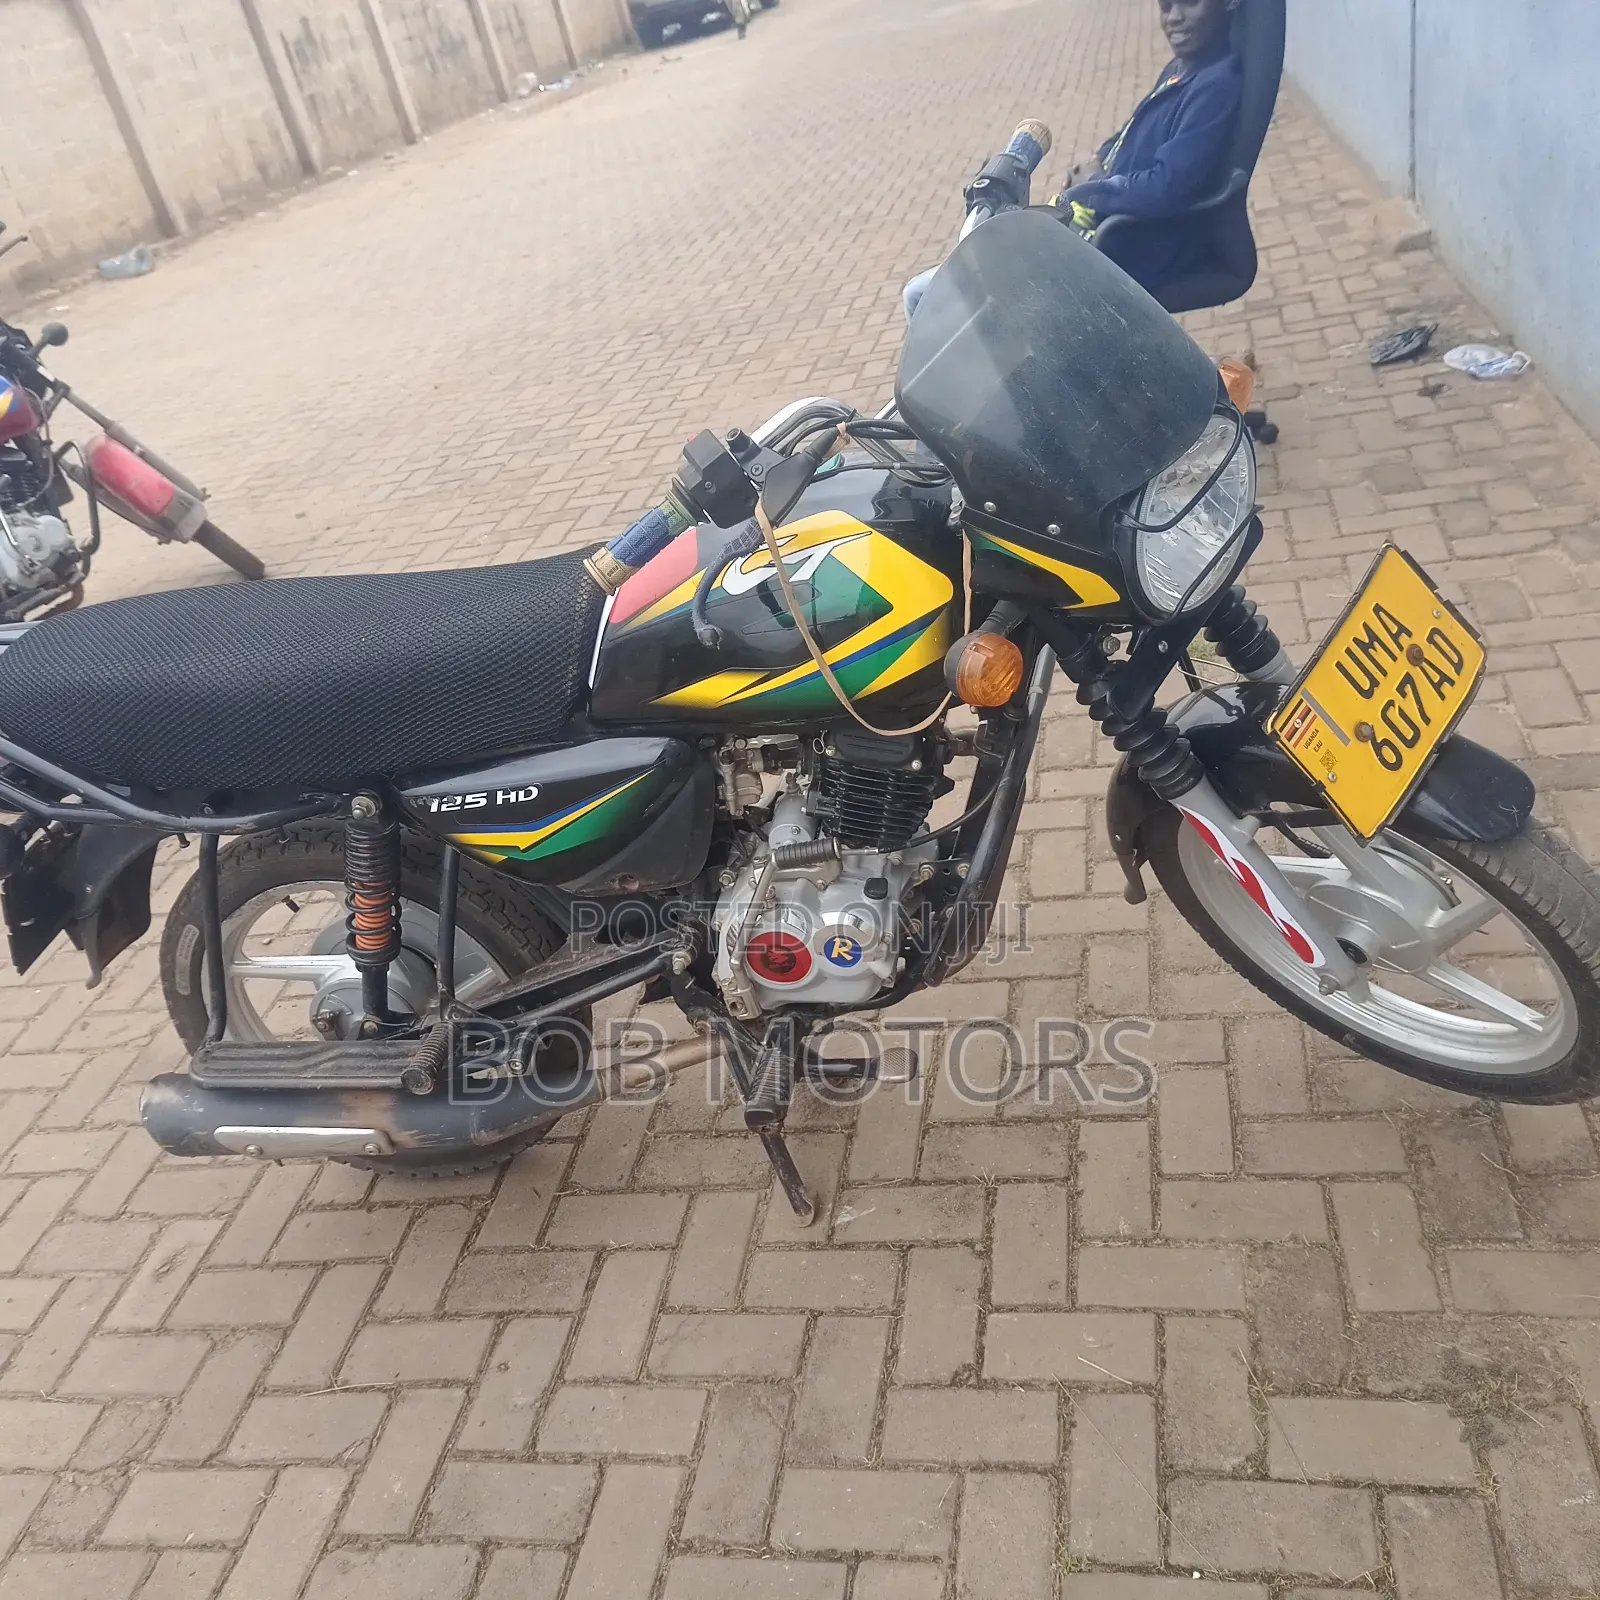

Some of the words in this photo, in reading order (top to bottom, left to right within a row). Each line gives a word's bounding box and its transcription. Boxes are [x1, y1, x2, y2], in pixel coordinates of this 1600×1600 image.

[1335, 602, 1413, 700] UMA
[1369, 627, 1464, 771] 607AD
[1304, 728, 1319, 749] UGANDA
[1313, 740, 1323, 752] EAU
[430, 792, 487, 813] 125
[496, 786, 539, 805] HD
[831, 937, 853, 961] R
